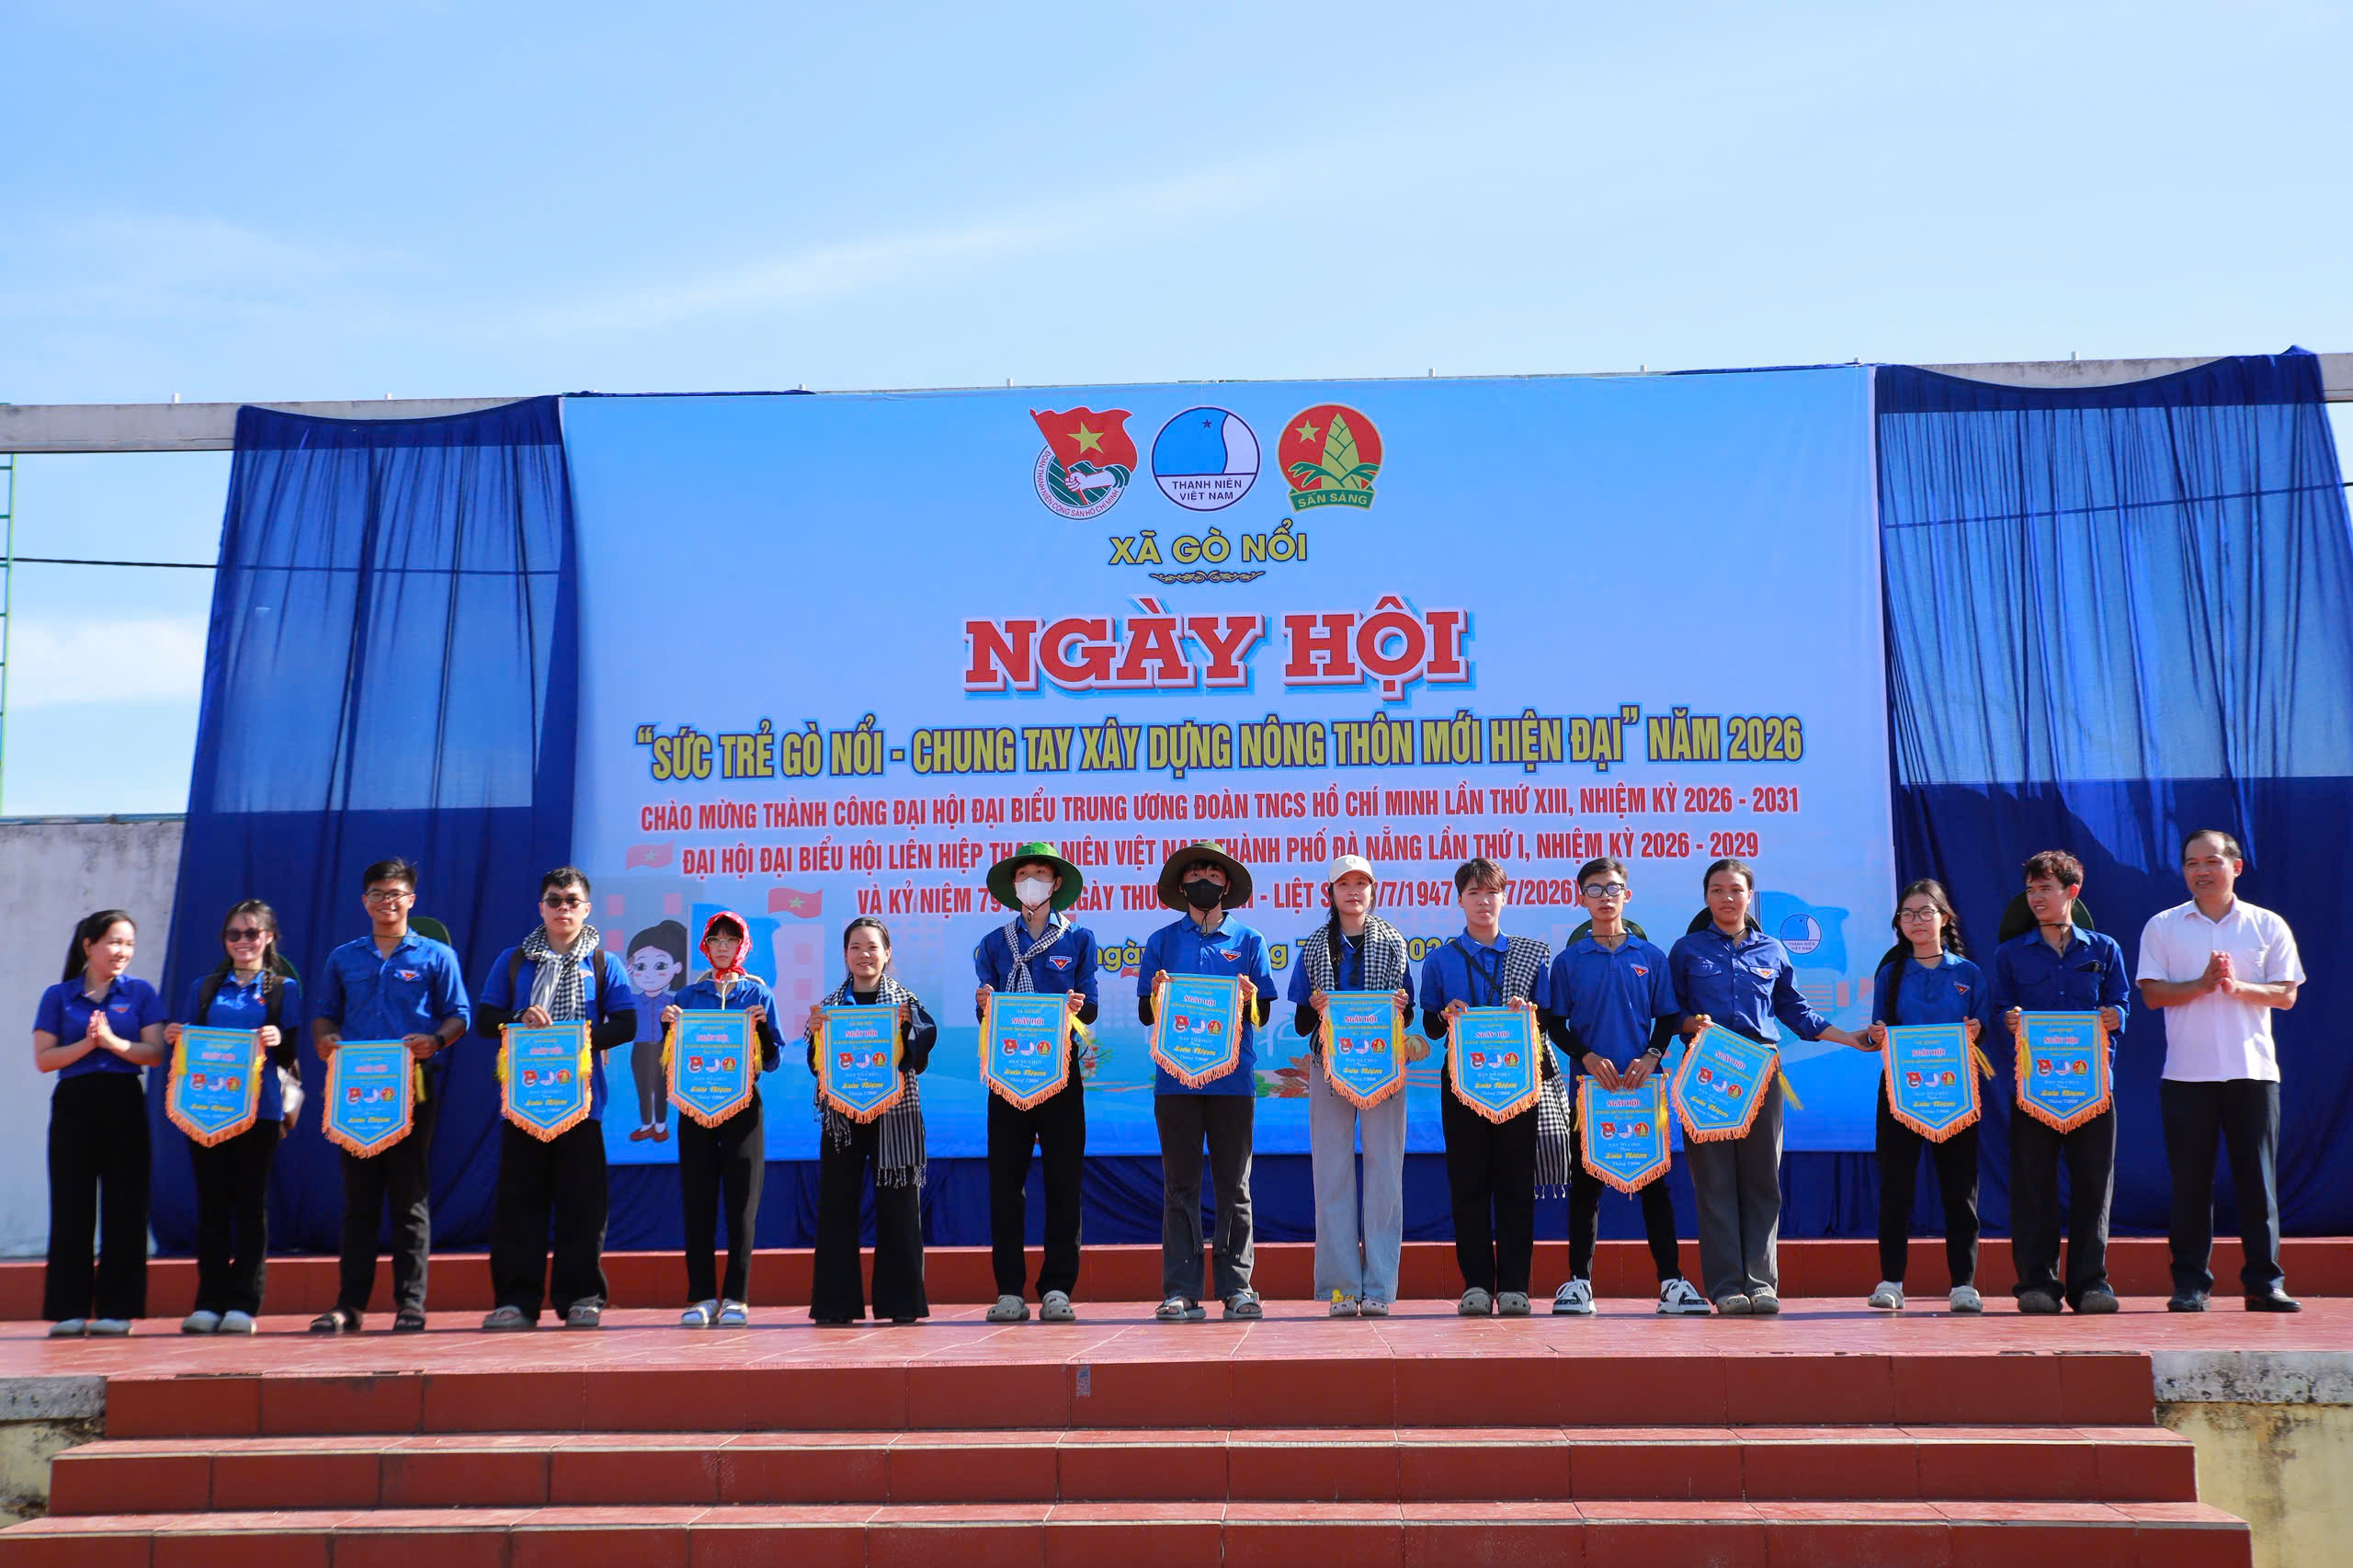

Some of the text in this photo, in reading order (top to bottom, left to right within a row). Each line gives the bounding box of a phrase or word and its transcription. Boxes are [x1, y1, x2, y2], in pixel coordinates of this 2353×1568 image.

[1172, 478, 1242, 490] THANH NIÊN
[1179, 491, 1233, 502] VIỆT NAM
[1329, 492, 1368, 505] SÀNG
[1108, 518, 1307, 564] XÃ GÒ NỔI
[964, 597, 1469, 700] NGÀY HỘI
[719, 718, 774, 778] TRẺ
[781, 721, 823, 777] GÒ
[829, 712, 883, 776] NỔI
[890, 748, 904, 762] -
[912, 727, 1016, 773] CHUNG
[1022, 726, 1075, 771] TAY
[1079, 717, 1142, 771] XÂY
[1147, 721, 1233, 779] DỰNG
[1239, 713, 1326, 768] NÔNG
[1332, 710, 1414, 766] THÔN
[1421, 709, 1483, 764] MỚI
[1489, 708, 1563, 773] HIỆN
[1647, 707, 1721, 762] NĂM
[1727, 716, 1803, 762] 2026
[642, 801, 692, 831] CHÀO
[699, 799, 756, 829] MỪNG
[764, 797, 827, 828] THÀNH
[834, 795, 887, 826] CÔNG
[892, 799, 926, 830] ĐẠI
[933, 793, 966, 829] HỘI
[972, 798, 1005, 829] ĐẠI
[1011, 788, 1055, 823] BIỂU
[1062, 795, 1128, 822] TRUNG
[1133, 793, 1188, 821] ƯƠNG
[1194, 789, 1249, 820] ĐOÀN
[1255, 791, 1306, 818] TNCS
[1313, 783, 1339, 817] HỒ
[1345, 786, 1379, 817] CHÍ
[1385, 790, 1438, 815] MINH
[1445, 780, 1484, 815] LẦN
[1490, 783, 1530, 814] THỨ
[1534, 788, 1574, 814] XIII,
[1580, 782, 1646, 819] NHIỆM
[1653, 781, 1677, 812] KỲ
[1684, 786, 1733, 812] 2026
[1753, 786, 1798, 812] 2031
[683, 848, 715, 880] ĐẠI
[722, 843, 754, 878] HỘI
[760, 846, 793, 878] ĐẠI
[799, 835, 843, 872] BIỂU
[850, 839, 882, 876] HỘI
[889, 838, 932, 869] LIÊN
[938, 837, 983, 874] HIỆP
[1061, 835, 1109, 866] NIÊN
[1115, 835, 1156, 870] VIỆT
[1286, 827, 1326, 862] PHỐ
[1333, 831, 1359, 860] ĐÀ
[1367, 830, 1422, 861] NẴNG
[1428, 826, 1468, 860] LẦN
[1473, 828, 1513, 858] THỨ
[1518, 834, 1530, 861] I,
[1537, 827, 1604, 864] NHIỆM
[1610, 827, 1634, 858] KỲ
[1641, 832, 1690, 858] 2026
[1710, 832, 1758, 858] 2029
[858, 884, 882, 915] VÀ
[889, 881, 914, 914] KỶ
[920, 882, 972, 918] NIỆM
[1067, 880, 1114, 911] GÀY
[1274, 877, 1314, 913] LIỆT
